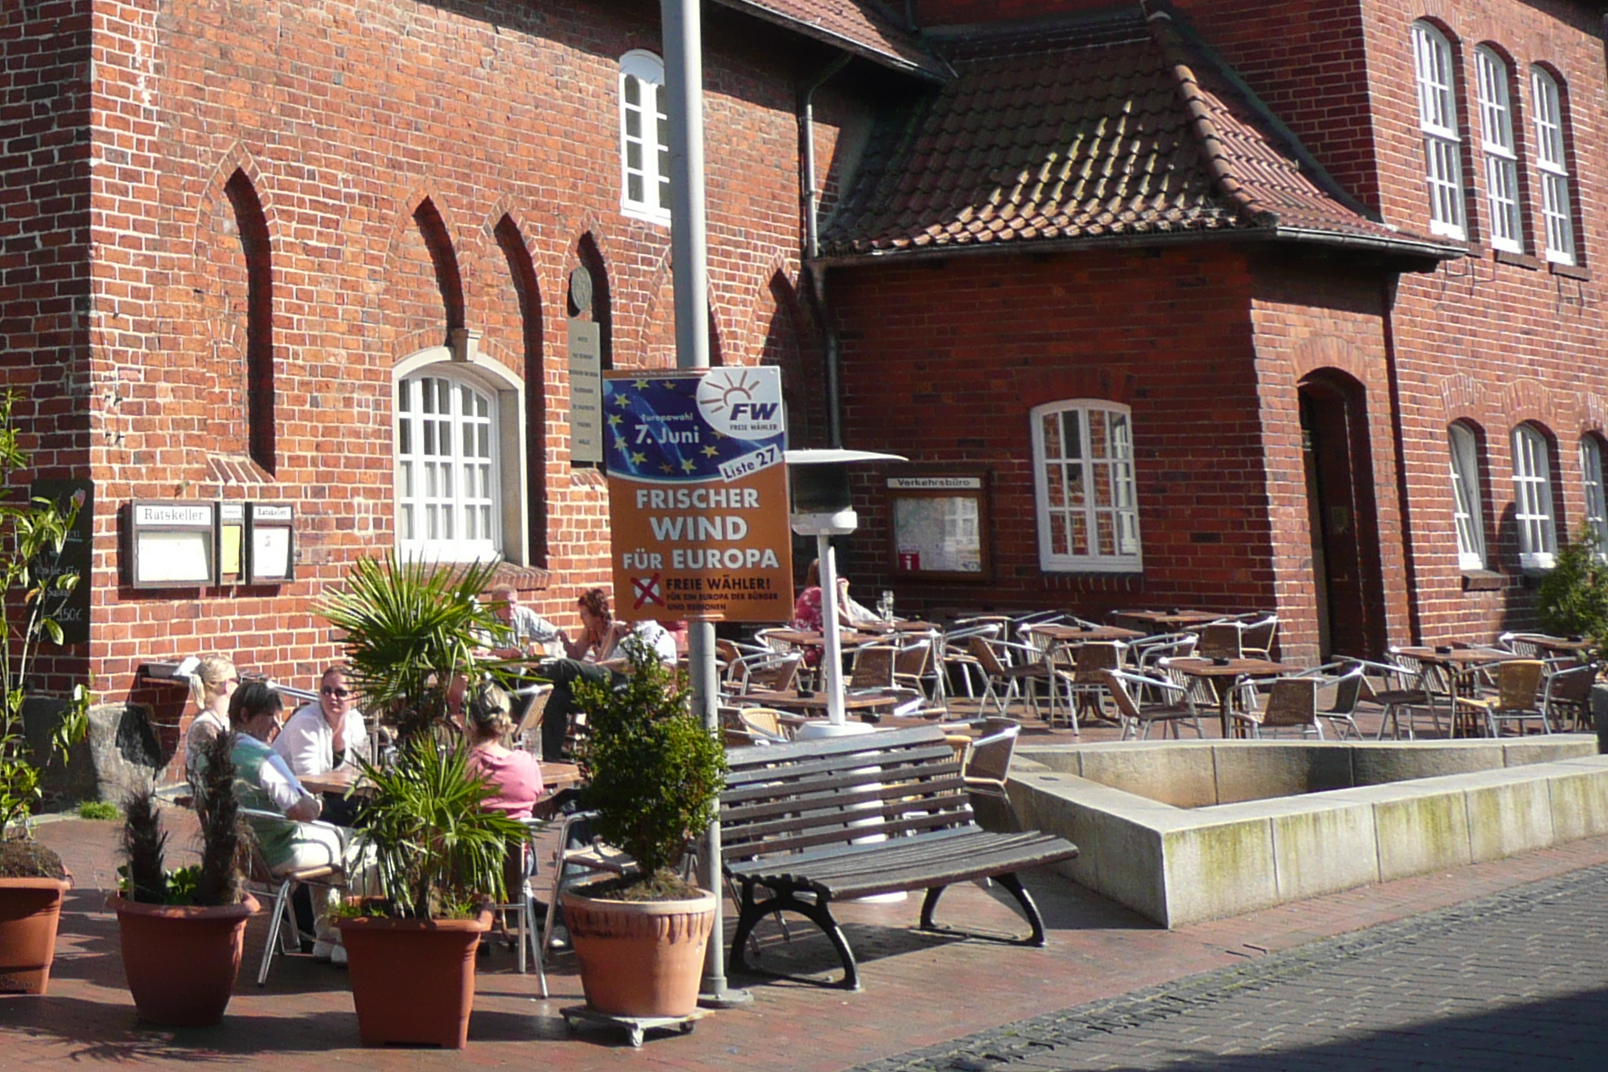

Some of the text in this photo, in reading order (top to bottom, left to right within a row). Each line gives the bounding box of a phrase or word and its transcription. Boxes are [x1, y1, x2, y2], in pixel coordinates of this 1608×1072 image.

[642, 413, 693, 423] Europawahl
[729, 403, 778, 421] FW
[635, 425, 700, 444] 7. Juni
[723, 447, 776, 479] Liste 27
[897, 478, 970, 487] Verkehrsbüro
[636, 488, 760, 509] FRISCHER
[144, 508, 204, 521] Ratskeller
[649, 516, 748, 541] WIND
[623, 548, 779, 569] FÜR EUROPA
[666, 574, 771, 590] FREIE WÄHLER!
[748, 592, 778, 600] BÜRGER
